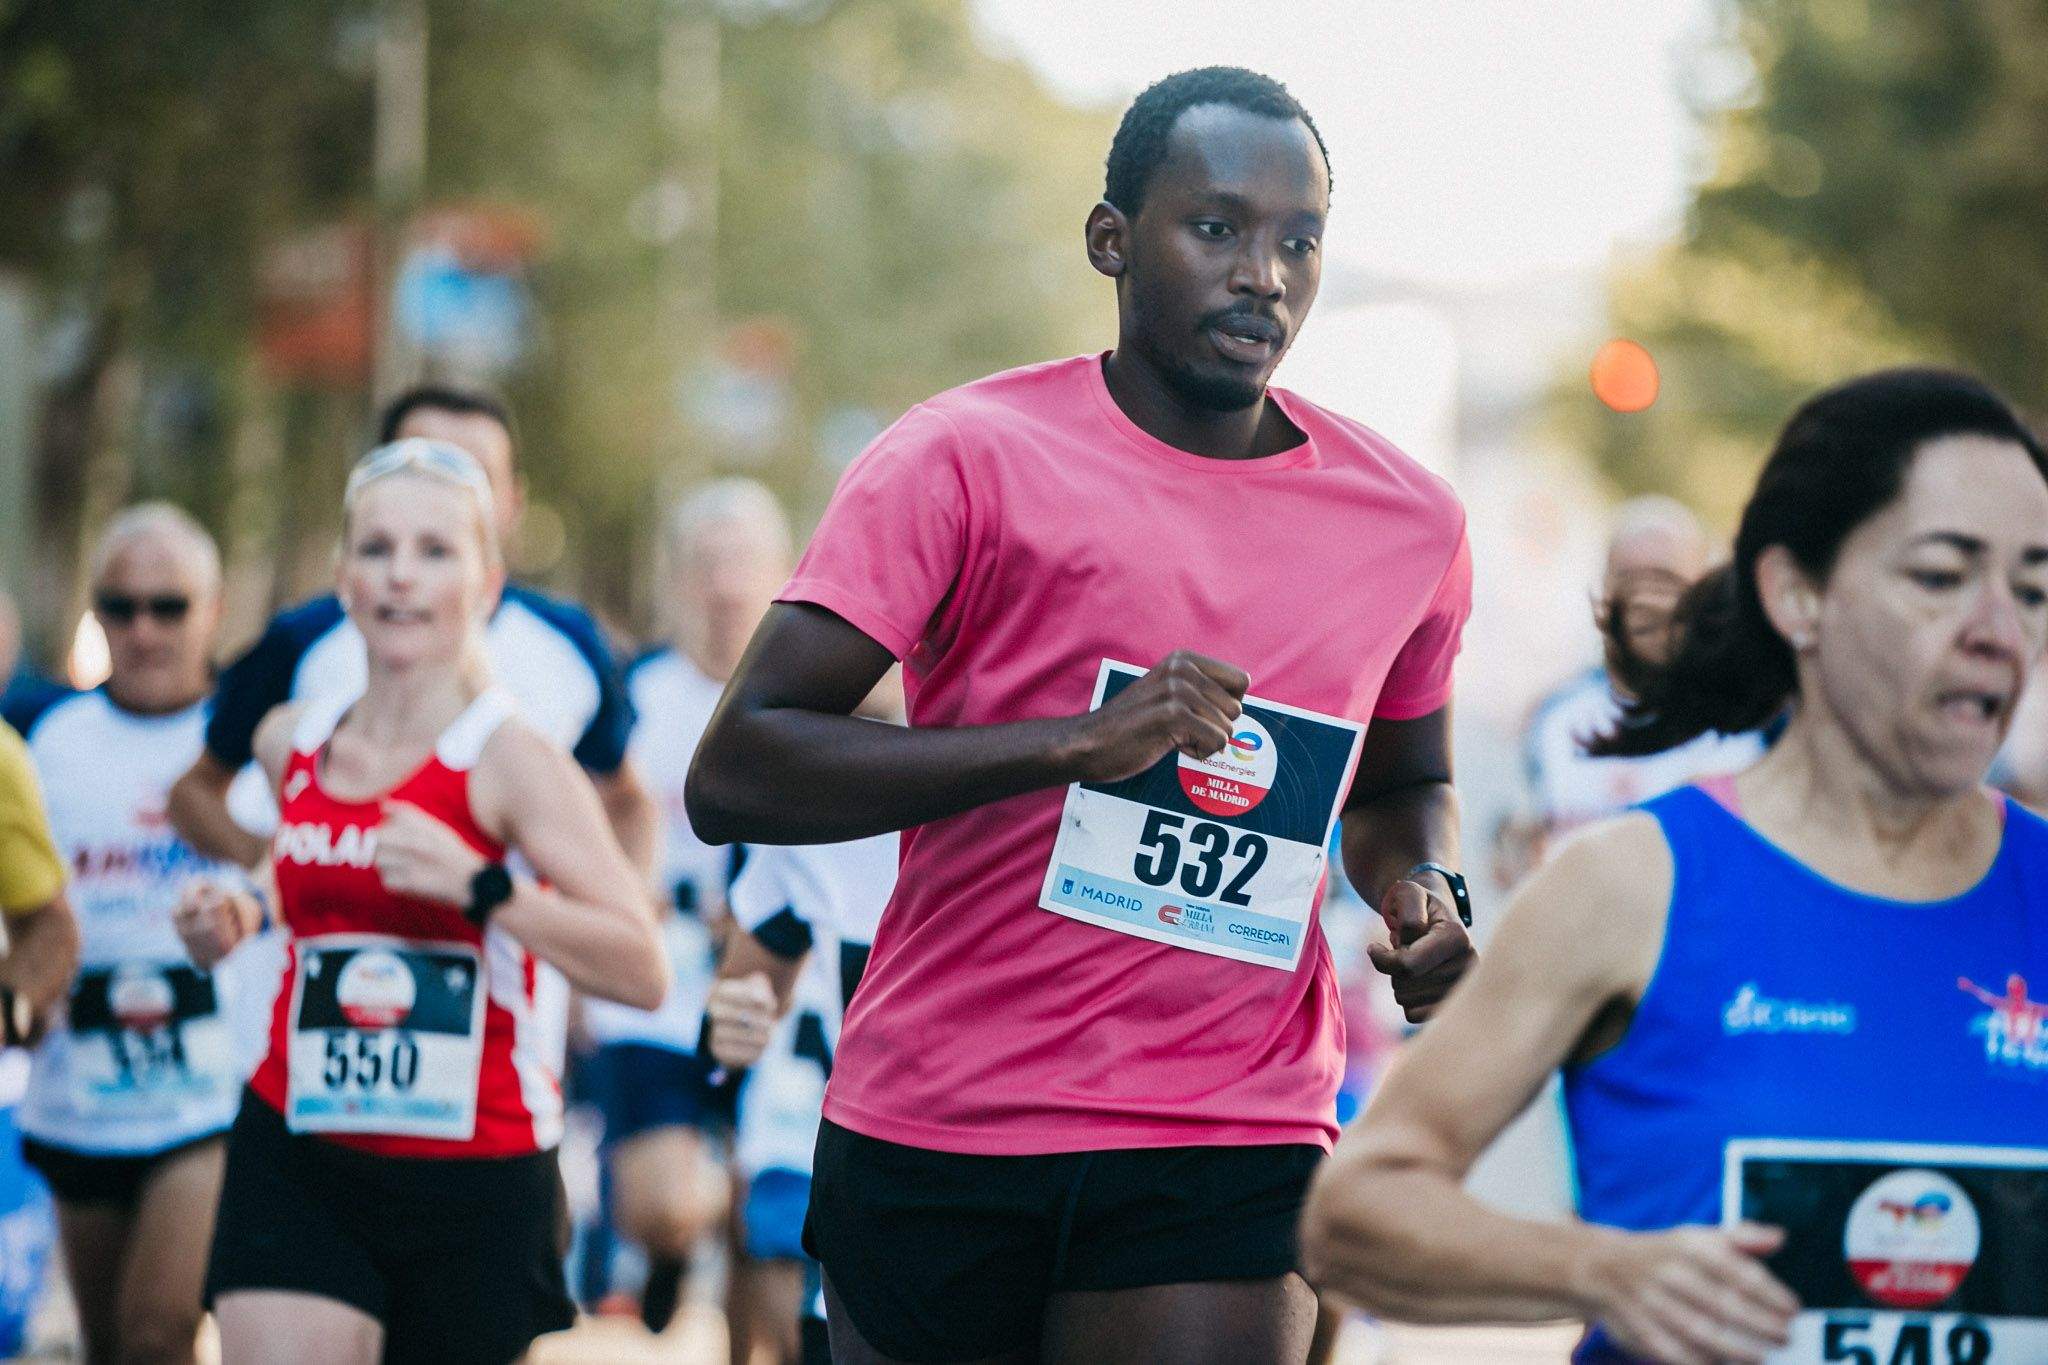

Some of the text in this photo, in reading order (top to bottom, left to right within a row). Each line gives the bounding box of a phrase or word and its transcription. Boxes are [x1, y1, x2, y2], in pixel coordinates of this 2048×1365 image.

[1201, 758, 1256, 777] otalEnergies
[1191, 785, 1250, 807] DE MADRID
[1207, 777, 1239, 793] MILLA
[1133, 809, 1268, 906] 532
[1081, 886, 1142, 911] MADRID
[1185, 909, 1213, 923] MILLA
[323, 1032, 420, 1090] 550
[1823, 1312, 1992, 1365] 548
